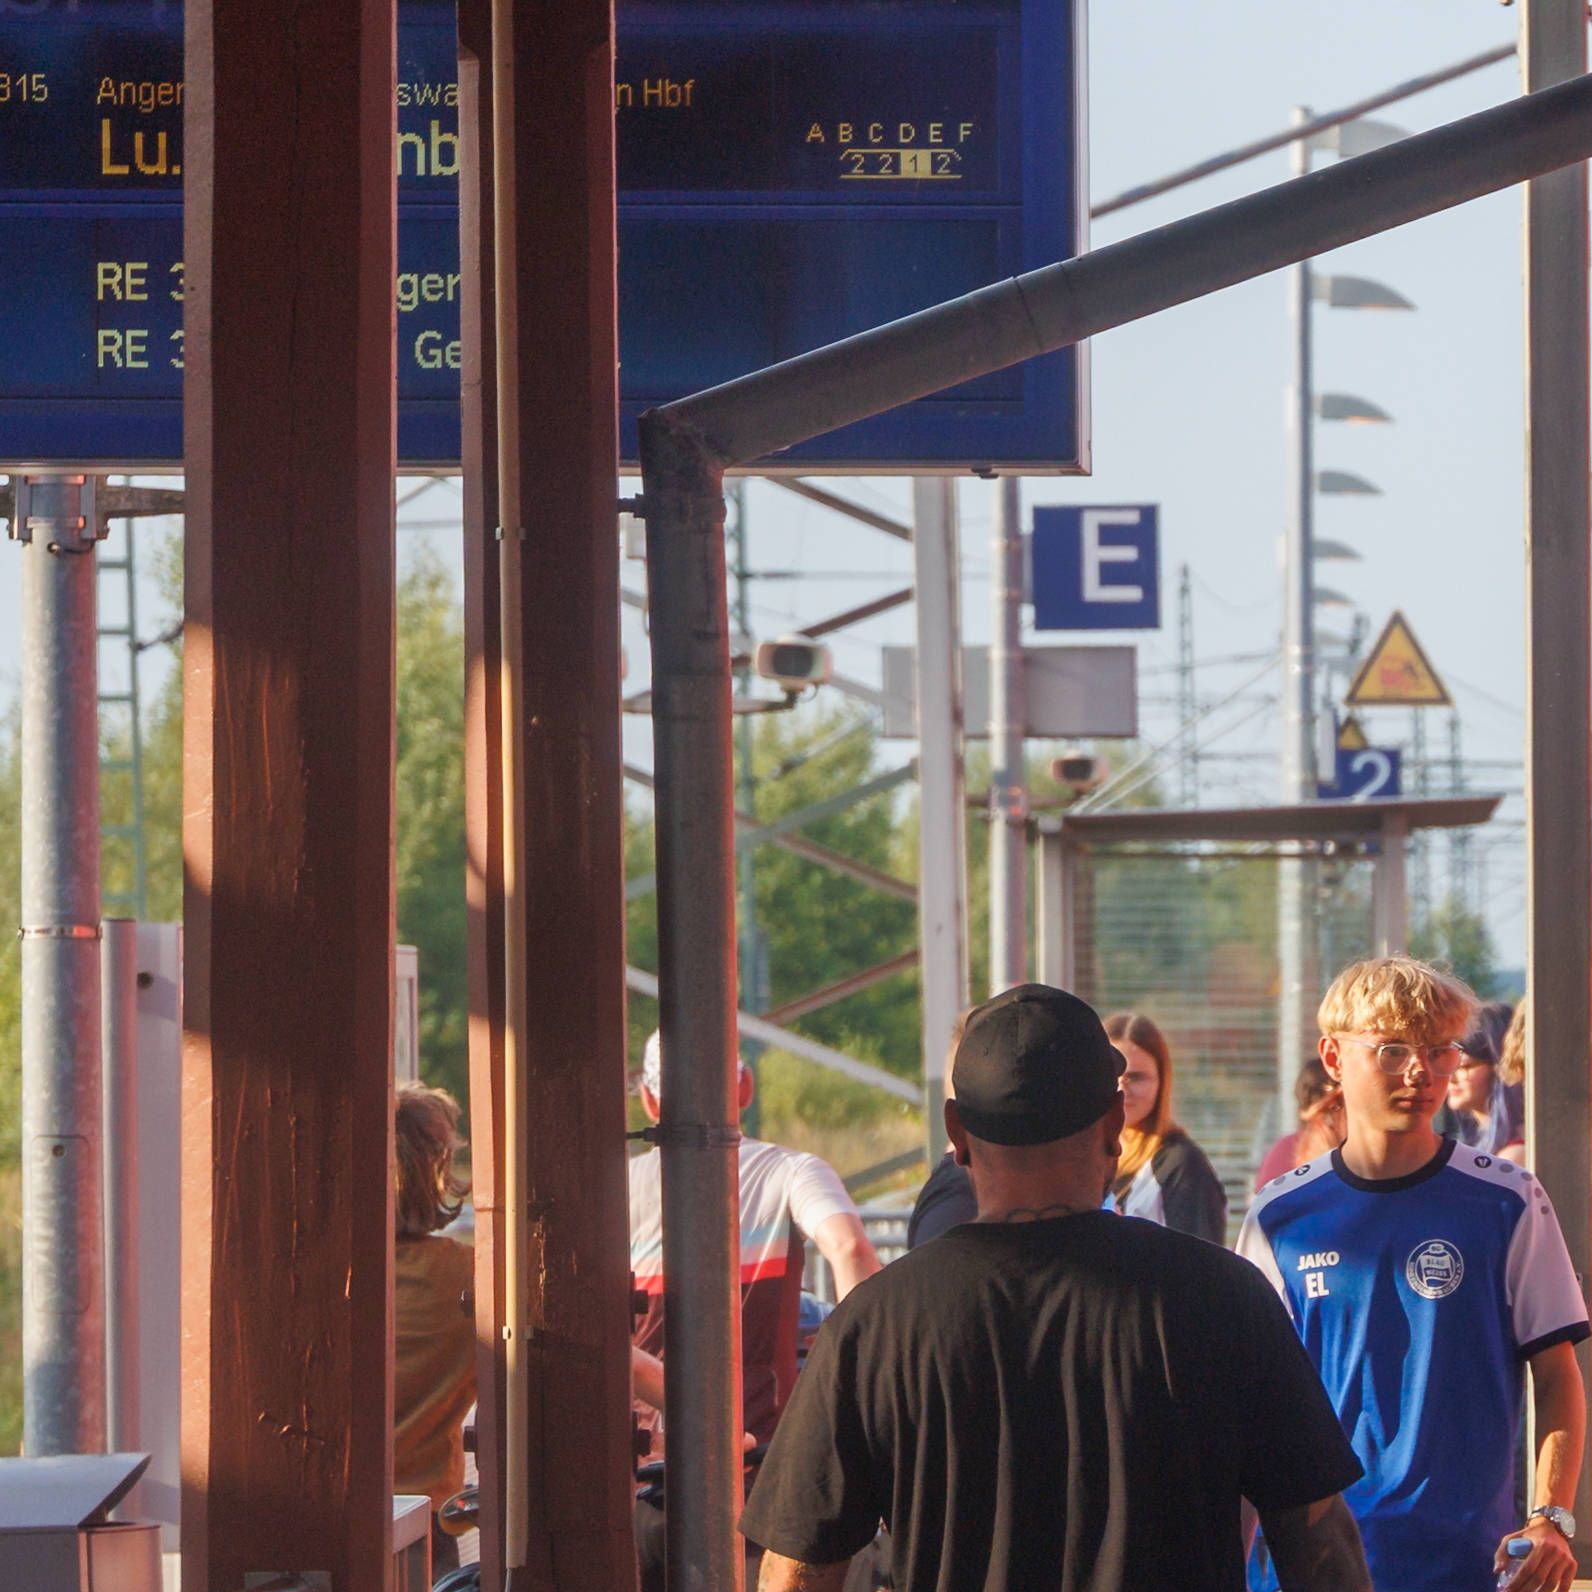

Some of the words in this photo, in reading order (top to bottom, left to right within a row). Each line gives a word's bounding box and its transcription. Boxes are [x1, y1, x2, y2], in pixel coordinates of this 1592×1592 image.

[97, 76, 184, 113] Anger
[396, 83, 460, 107] swa
[616, 83, 632, 107] n
[644, 79, 695, 107] Hbf
[102, 118, 182, 175] Lu.
[397, 120, 461, 176] nb
[806, 122, 825, 143] A
[838, 122, 853, 143] B
[868, 122, 884, 143] C
[899, 122, 916, 143] D
[929, 122, 943, 143] E
[959, 122, 973, 143] F
[851, 153, 865, 174] 2
[879, 153, 893, 174] 2
[909, 153, 918, 174] 1
[937, 153, 951, 174] 2
[97, 262, 149, 301] RE
[397, 273, 461, 311] ger
[97, 329, 149, 369] RE
[415, 330, 461, 369] Ge
[1080, 508, 1143, 602] E
[1351, 751, 1392, 801] 2
[1297, 1250, 1341, 1272] JAKO
[1305, 1272, 1330, 1298] EL
